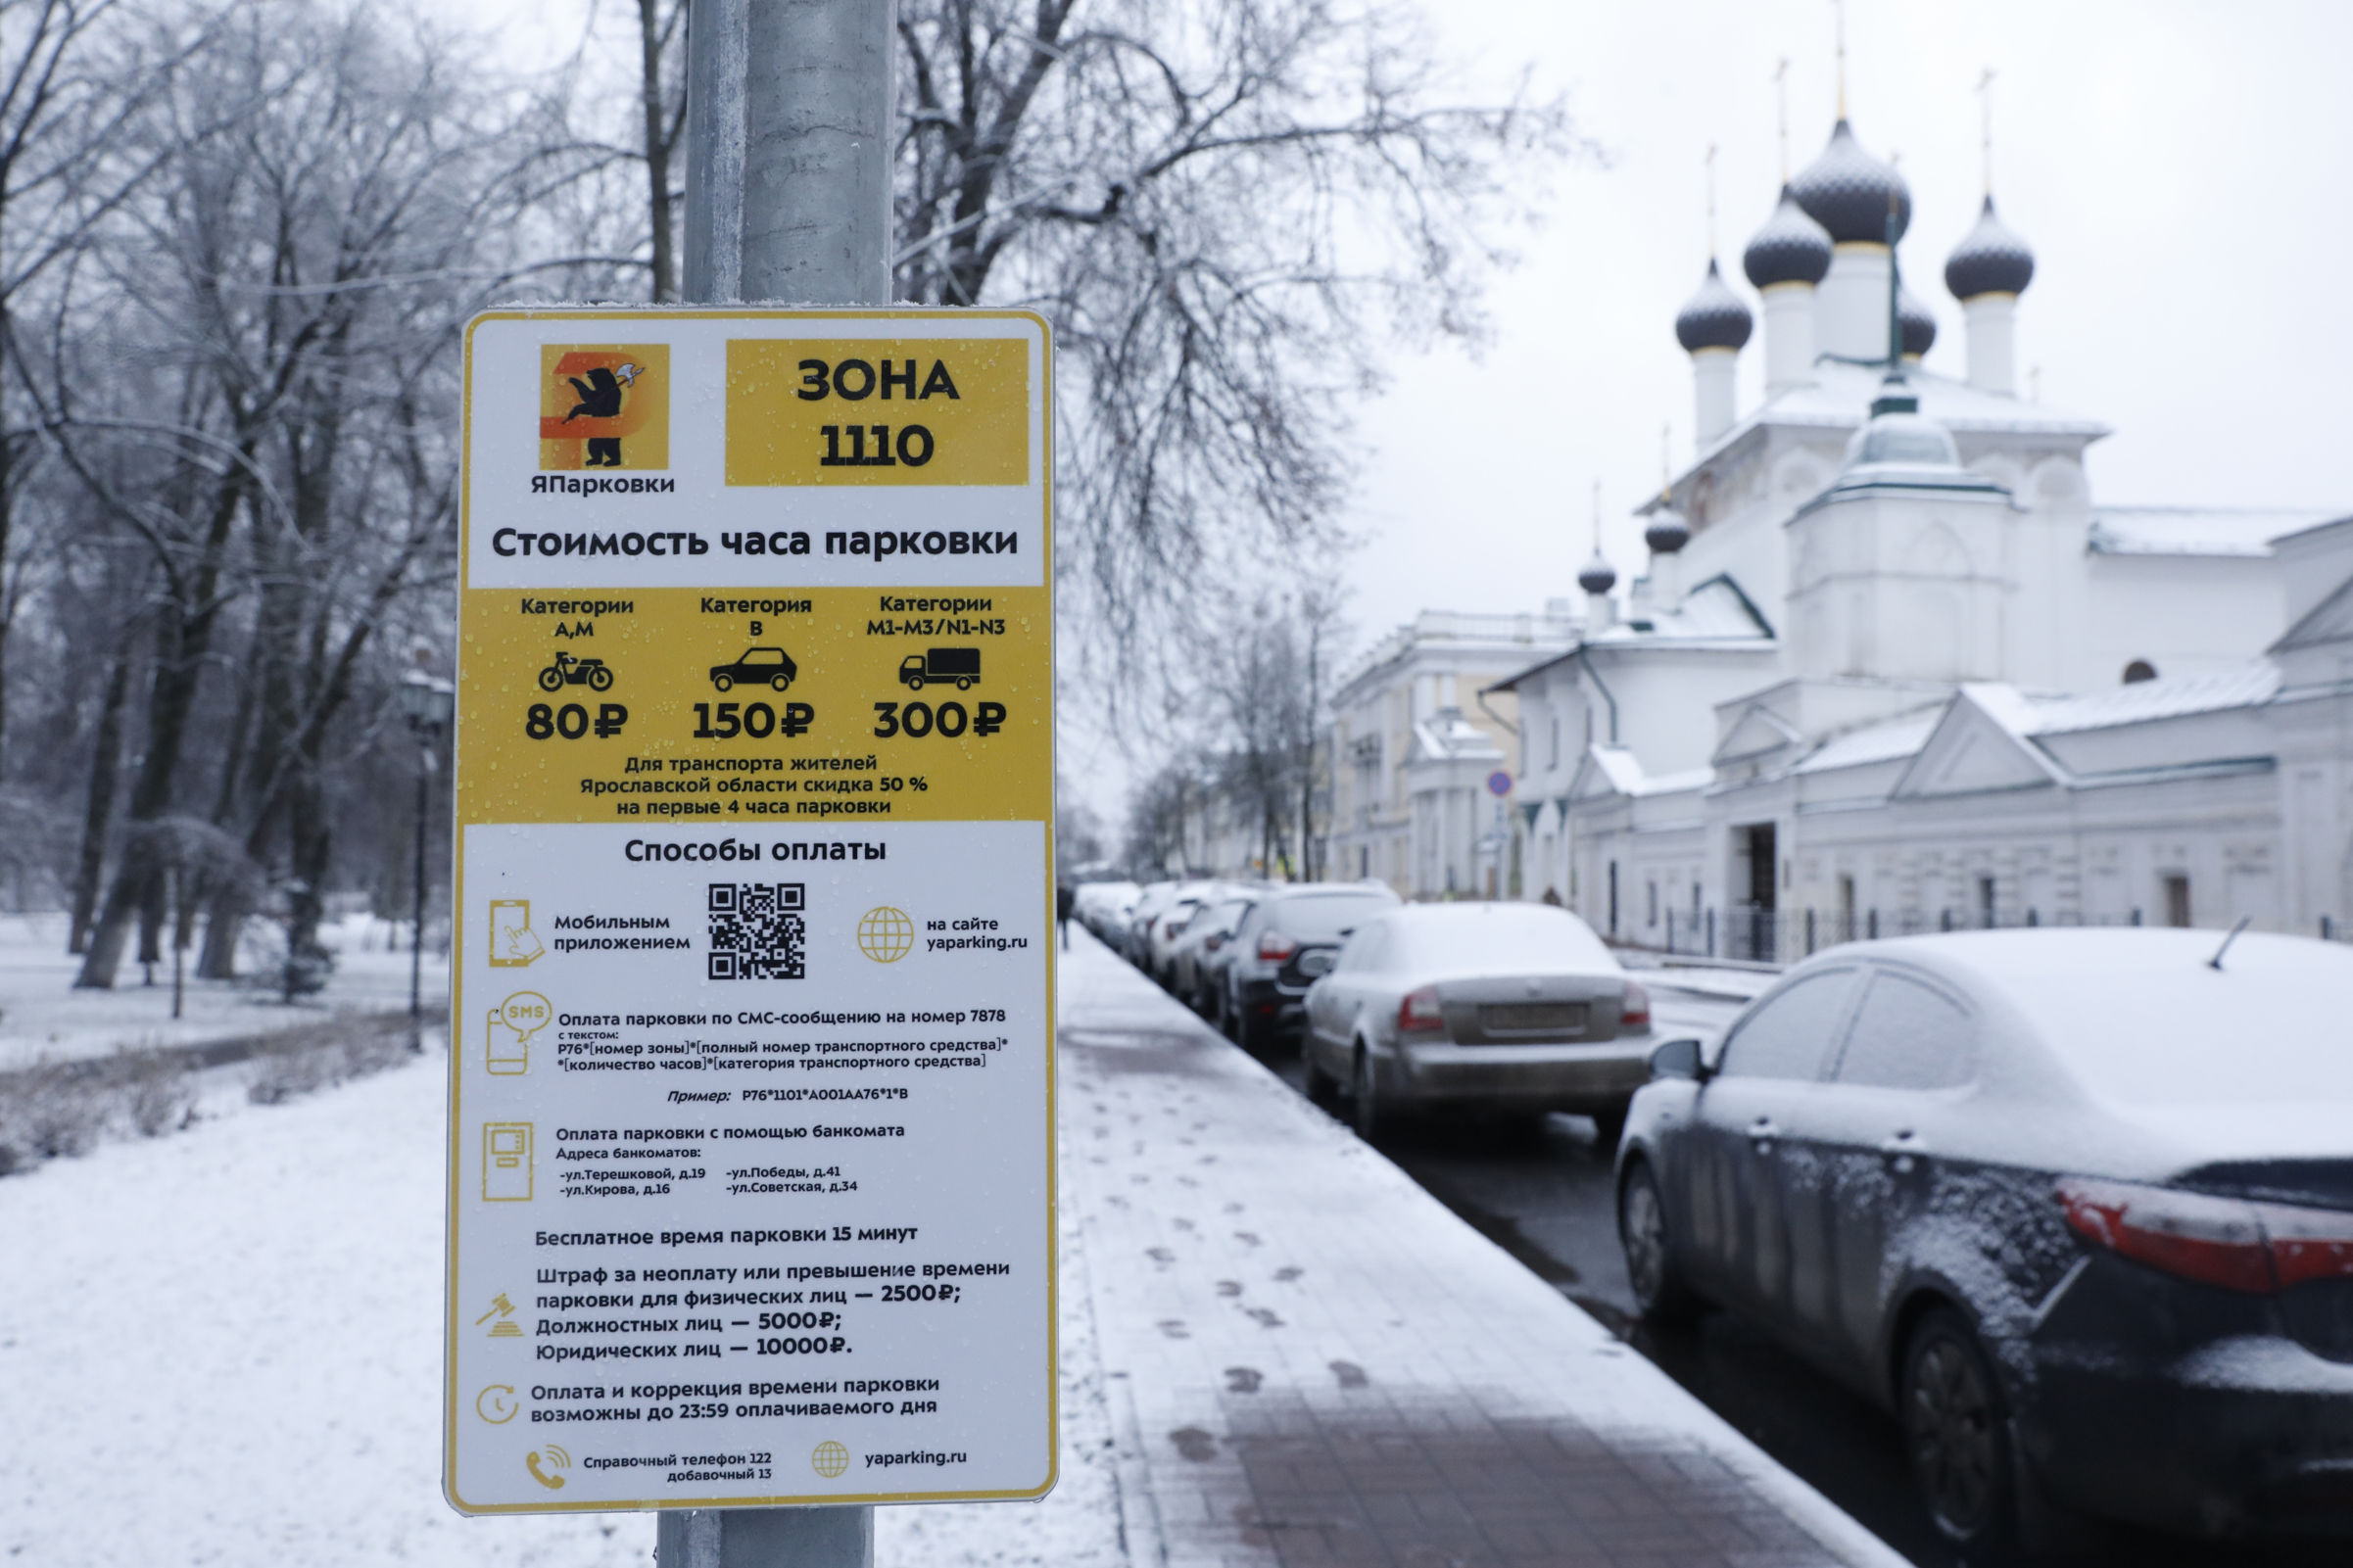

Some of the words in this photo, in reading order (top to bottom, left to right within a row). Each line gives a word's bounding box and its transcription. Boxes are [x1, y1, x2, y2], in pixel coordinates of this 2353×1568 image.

[797, 358, 961, 402] ЗОНА
[820, 424, 935, 467] 1110
[531, 475, 674, 498] ЯПарковки
[493, 528, 709, 556] Стоимость
[721, 531, 810, 555] часа
[826, 531, 1017, 562] парковки
[521, 598, 634, 618] Категории
[701, 597, 812, 617] Категория
[881, 596, 991, 615] Категории
[624, 757, 662, 774] Для
[669, 758, 783, 775] транспорта
[790, 754, 877, 771] жителей
[581, 777, 710, 796] Ярославской
[717, 777, 797, 792] области
[803, 780, 873, 794] скидка
[880, 777, 904, 791] 50
[909, 776, 928, 791] %
[617, 802, 640, 815] на
[647, 802, 721, 818] первые
[728, 799, 740, 814] 4
[745, 802, 790, 814] часа
[796, 801, 890, 817] парковки
[625, 837, 760, 862] Способы
[772, 842, 886, 861] оплаты
[554, 915, 670, 929] Мобильным
[927, 921, 946, 930] на
[952, 917, 998, 930] сайте
[554, 937, 691, 953] приложением
[927, 935, 1028, 952] yaparking.ru
[507, 1006, 545, 1019] SMS
[558, 1014, 620, 1026] Оплата
[626, 1015, 706, 1028] парковки
[712, 1014, 733, 1024] по
[738, 1011, 881, 1025] СМС-сообщению
[887, 1013, 905, 1022] на
[911, 1012, 966, 1025] номер
[970, 1009, 1006, 1022] 7878
[567, 1031, 619, 1040] текстом:
[762, 1043, 811, 1055] номер
[815, 1042, 926, 1055] транспортного
[798, 1058, 910, 1070] транспортного
[667, 1091, 732, 1105] Пример:
[556, 1128, 618, 1141] Оплата
[624, 1129, 704, 1143] парковки
[709, 1128, 718, 1139] с
[724, 1127, 807, 1140] помощью
[812, 1124, 904, 1138] банкомата
[555, 1147, 608, 1162] Адреса
[612, 1148, 701, 1159] банкоматов:
[560, 1167, 675, 1182] -ул.Терешковой,
[679, 1168, 705, 1180] д.19
[726, 1166, 809, 1180] -ул.Победы,
[813, 1166, 840, 1178] д.41
[559, 1184, 639, 1198] -ул.Кирова,
[643, 1183, 670, 1196] д.16
[726, 1182, 826, 1196] -ул.Советская,
[829, 1181, 858, 1193] д.34
[536, 1231, 653, 1246] Бесплатное
[660, 1231, 723, 1248] время
[731, 1230, 826, 1246] парковки
[833, 1226, 851, 1241] 15
[858, 1228, 918, 1244] минут
[537, 1267, 608, 1287] Штраф
[614, 1269, 636, 1282] за
[643, 1268, 738, 1284] неоплату
[744, 1267, 780, 1280] или
[787, 1264, 916, 1282] превышение
[923, 1263, 1009, 1280] времени
[537, 1295, 634, 1311] парковки
[640, 1294, 678, 1308] для
[684, 1290, 803, 1309] физических
[809, 1291, 847, 1305] лиц
[536, 1319, 678, 1336] Должностных
[685, 1318, 723, 1333] лиц
[537, 1345, 677, 1363] Юридических
[683, 1344, 721, 1358] лиц
[531, 1385, 605, 1401] Оплата
[612, 1387, 624, 1398] и
[631, 1384, 742, 1401] коррекция
[748, 1382, 837, 1399] времени
[844, 1379, 939, 1396] парковки
[531, 1407, 641, 1422] возможны
[647, 1406, 674, 1422] до
[680, 1403, 729, 1418] 23:59
[736, 1402, 894, 1417] оплачиваемого
[900, 1401, 936, 1415] дня
[584, 1454, 677, 1471] Справочный
[681, 1453, 745, 1467] телефон
[749, 1452, 772, 1464] 122
[865, 1450, 967, 1468] yaparking.ru
[667, 1468, 754, 1483] добавочный
[758, 1468, 772, 1479] 13
